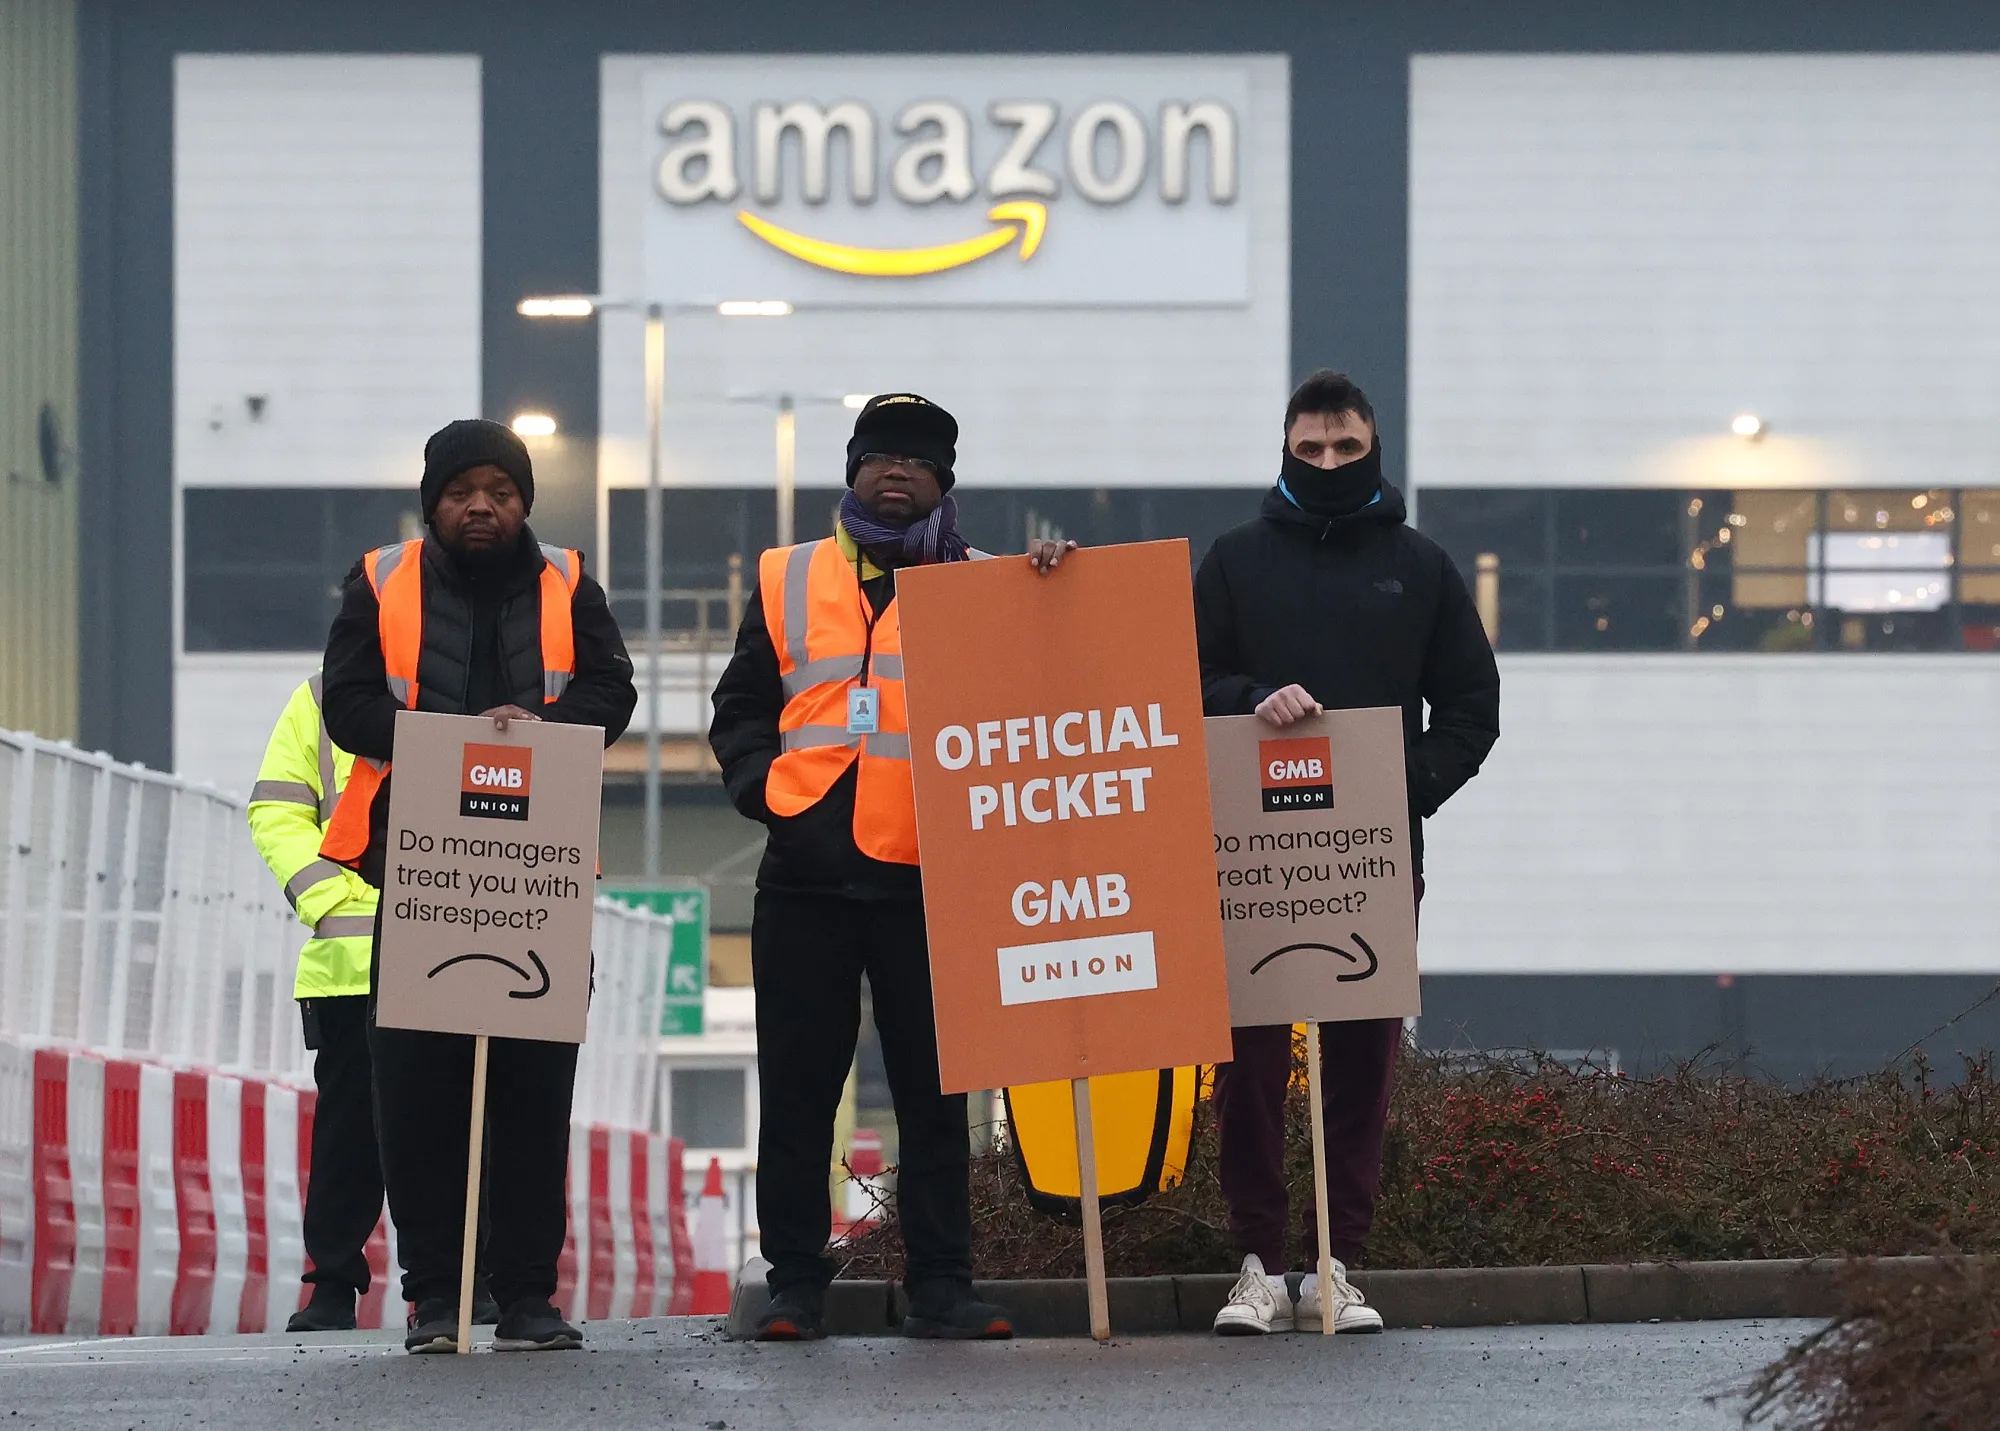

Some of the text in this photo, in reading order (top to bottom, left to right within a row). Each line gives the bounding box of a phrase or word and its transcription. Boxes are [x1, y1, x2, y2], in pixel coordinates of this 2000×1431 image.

[656, 99, 1237, 203] amazon
[935, 703, 1179, 771] OFFICIAL
[469, 764, 523, 788] GMB
[1268, 758, 1324, 780] GMB
[469, 800, 520, 813] UNION
[968, 766, 1153, 830] PICKET
[1272, 792, 1324, 804] UNION
[399, 829, 581, 868] Do managers
[1248, 825, 1393, 853] managers
[396, 864, 579, 899] treat you with
[1217, 855, 1397, 891] reat you with
[394, 897, 548, 932] disrespect?
[1011, 873, 1131, 927] GMB
[1021, 953, 1133, 983] UNION
